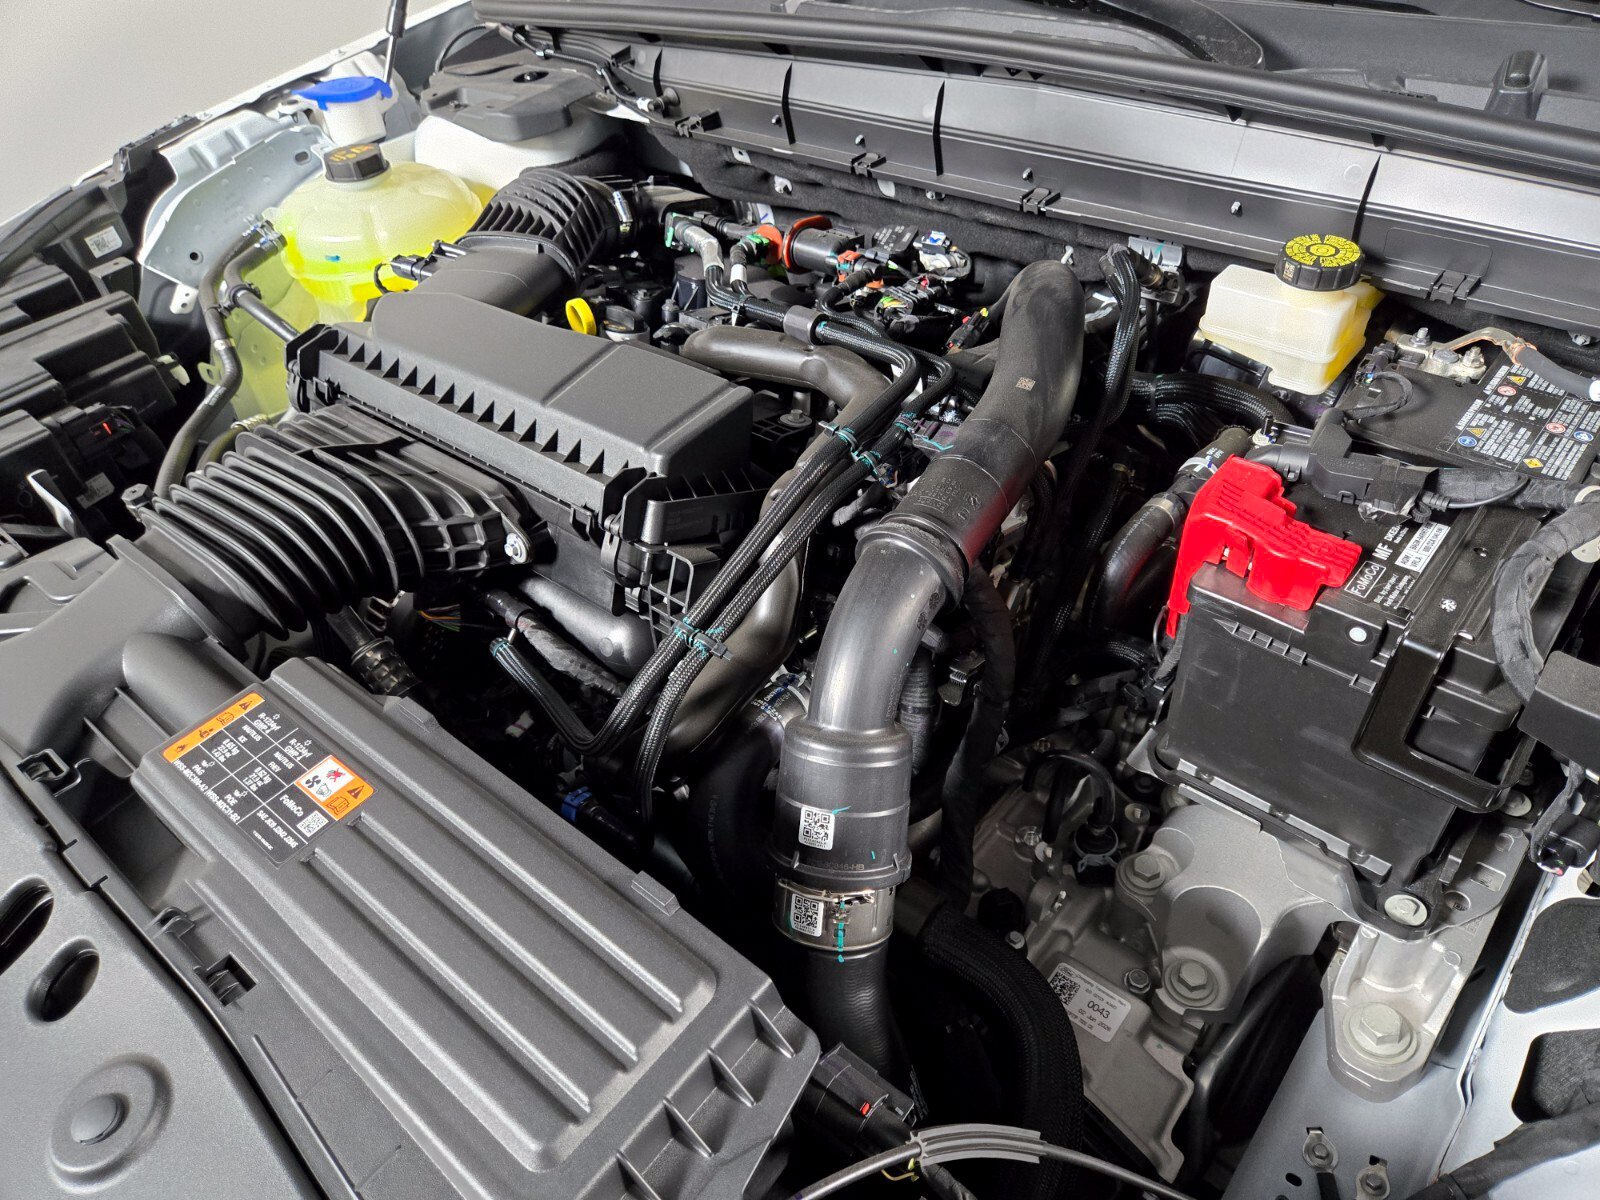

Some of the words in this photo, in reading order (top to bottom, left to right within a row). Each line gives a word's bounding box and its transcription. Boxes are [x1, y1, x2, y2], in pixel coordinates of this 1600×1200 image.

[1372, 543, 1393, 560] MF
[1400, 555, 1411, 564] AGM
[1351, 564, 1380, 595] FoMoCo
[258, 712, 281, 732] R-1234yf
[289, 739, 313, 758] R-1234yf
[192, 765, 205, 776] PAG
[224, 794, 238, 806] POE
[279, 795, 304, 817] FoMoCo
[257, 810, 268, 821] SAE
[1087, 1000, 1110, 1019] 0043
